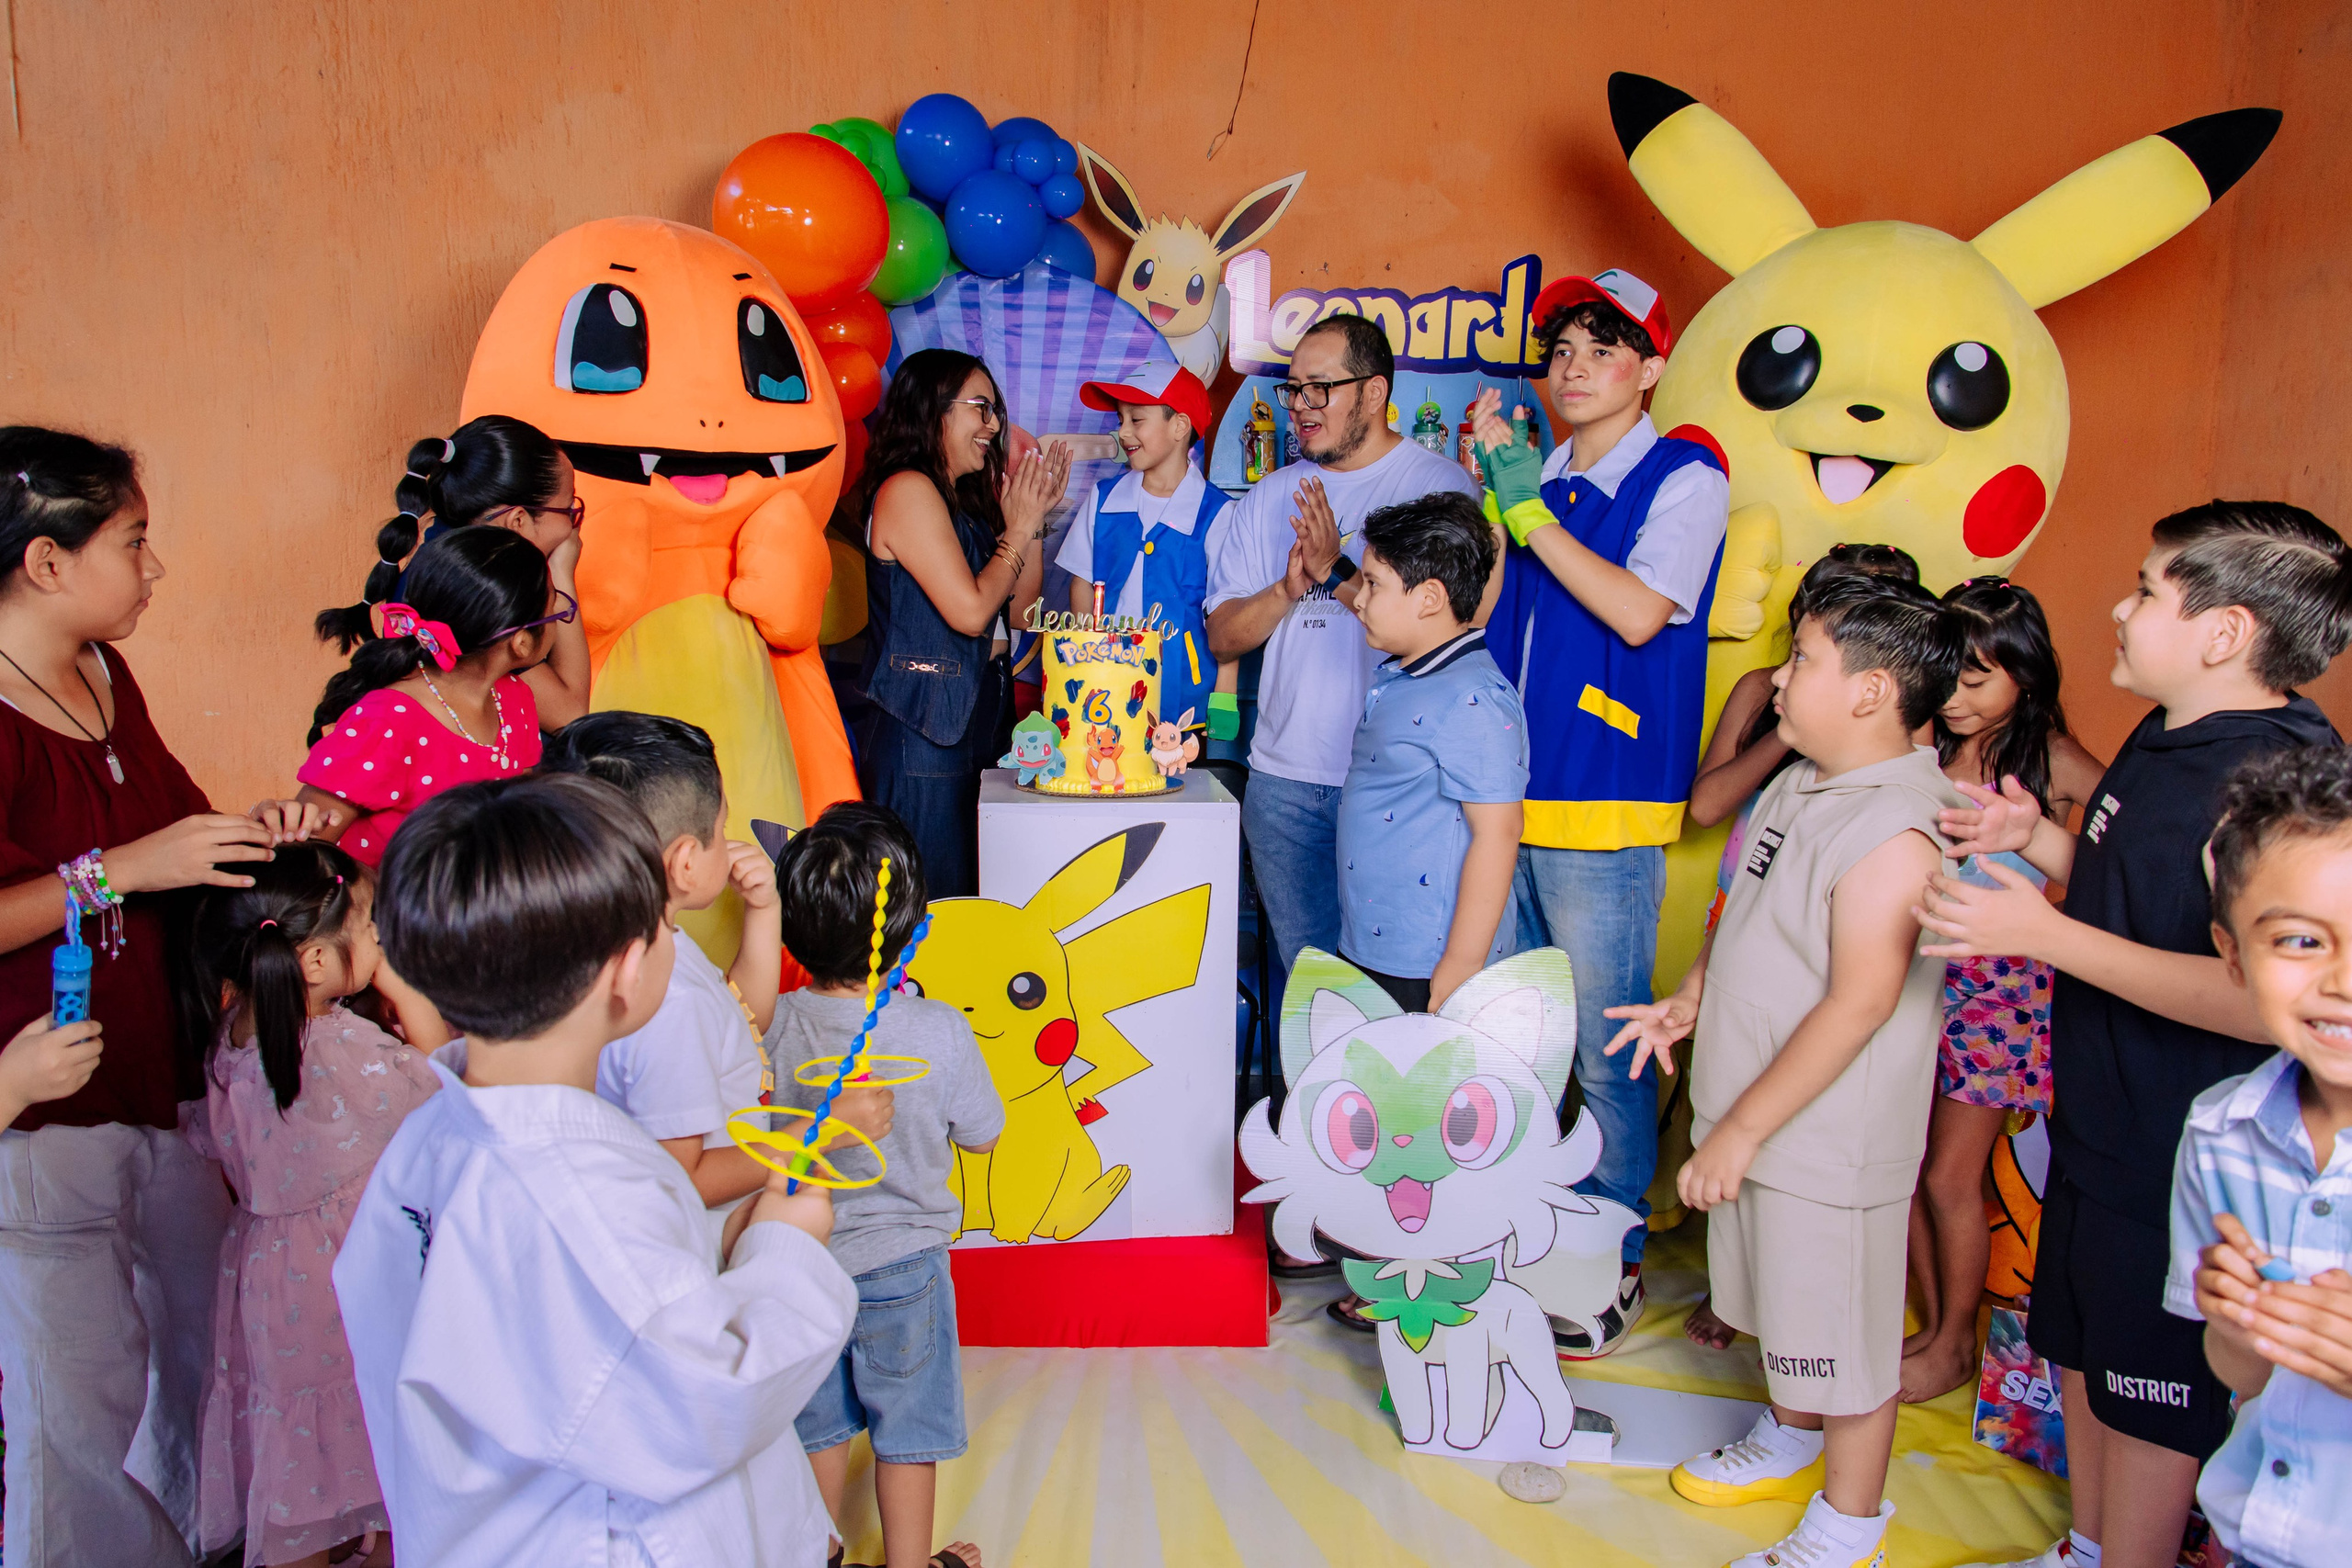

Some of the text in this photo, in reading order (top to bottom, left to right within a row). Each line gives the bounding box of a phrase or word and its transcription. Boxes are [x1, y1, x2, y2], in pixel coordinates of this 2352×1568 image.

[1023, 596, 1179, 641] Leonardo
[1312, 619, 1327, 628] 0134
[1087, 690, 1113, 726] 6
[1767, 1351, 1836, 1378] DISTRICT
[2106, 1369, 2191, 1408] DISTRICT
